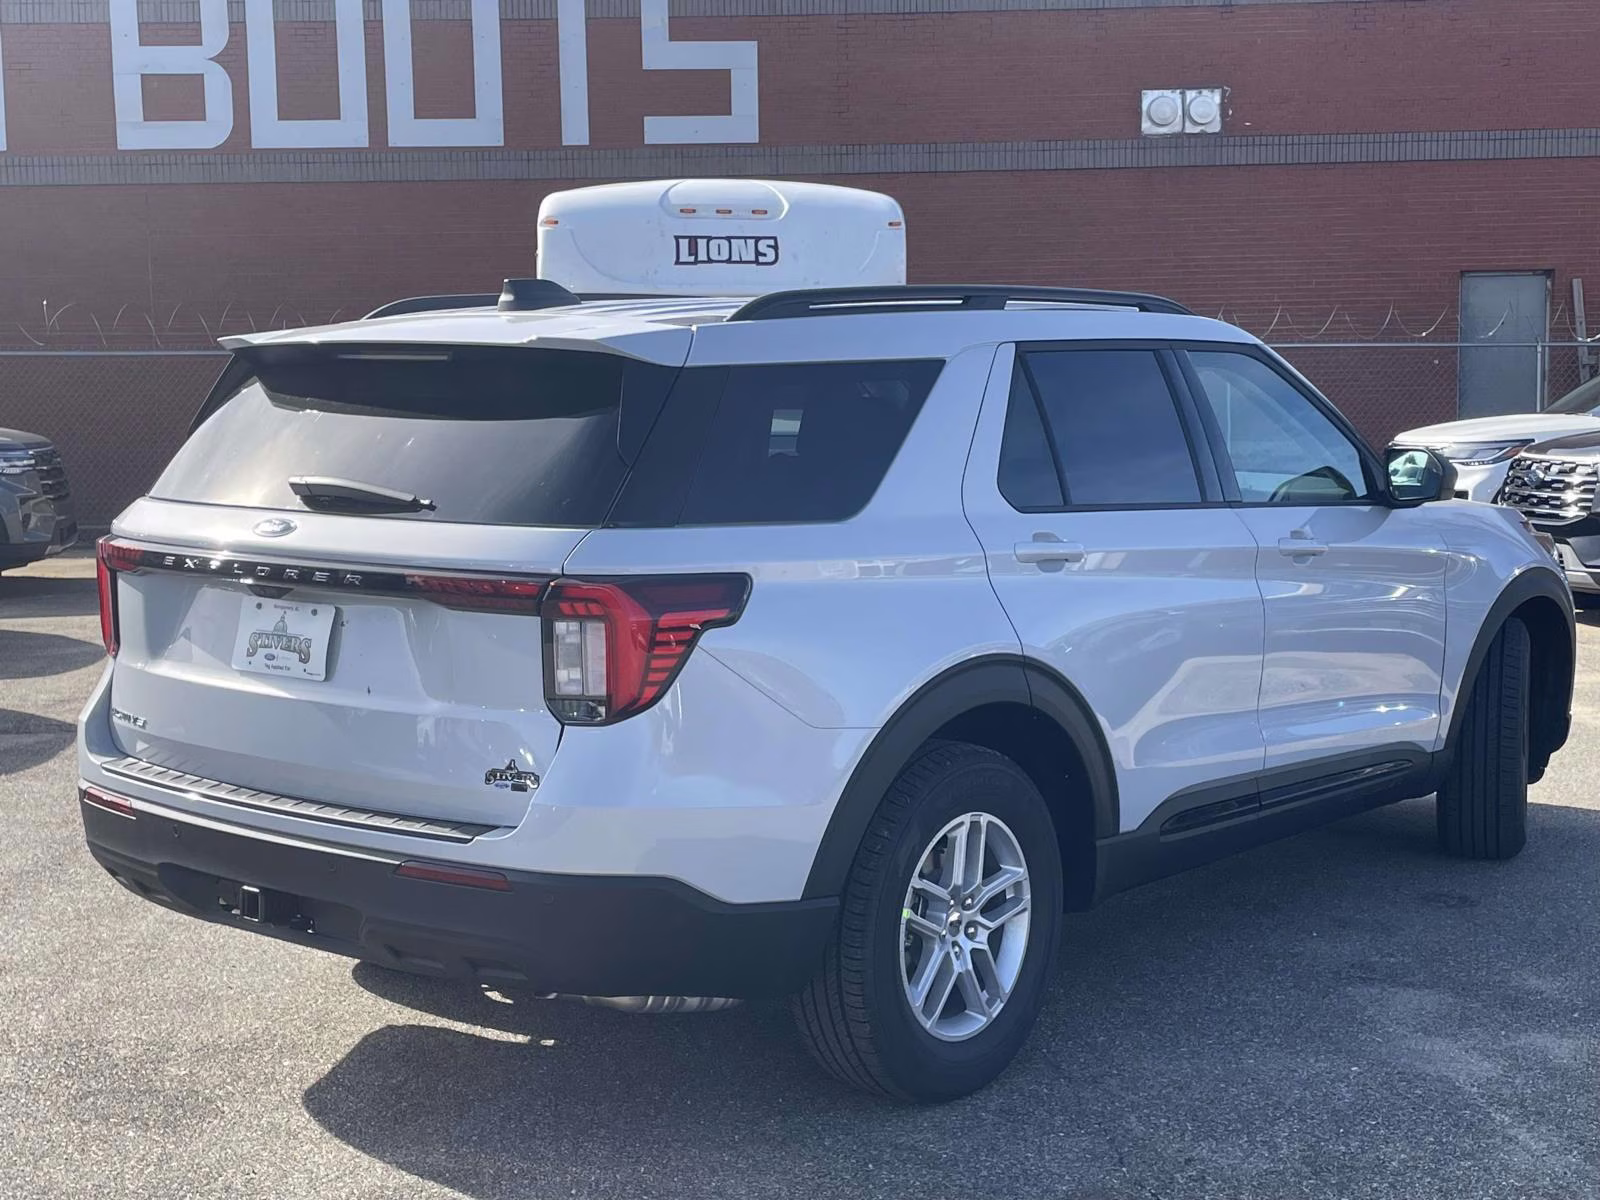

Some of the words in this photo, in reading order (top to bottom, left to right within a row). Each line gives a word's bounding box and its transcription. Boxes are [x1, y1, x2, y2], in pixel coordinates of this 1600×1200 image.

[673, 235, 779, 266] LIONS
[162, 555, 364, 586] EXPLORER
[246, 631, 313, 664] STIVERS
